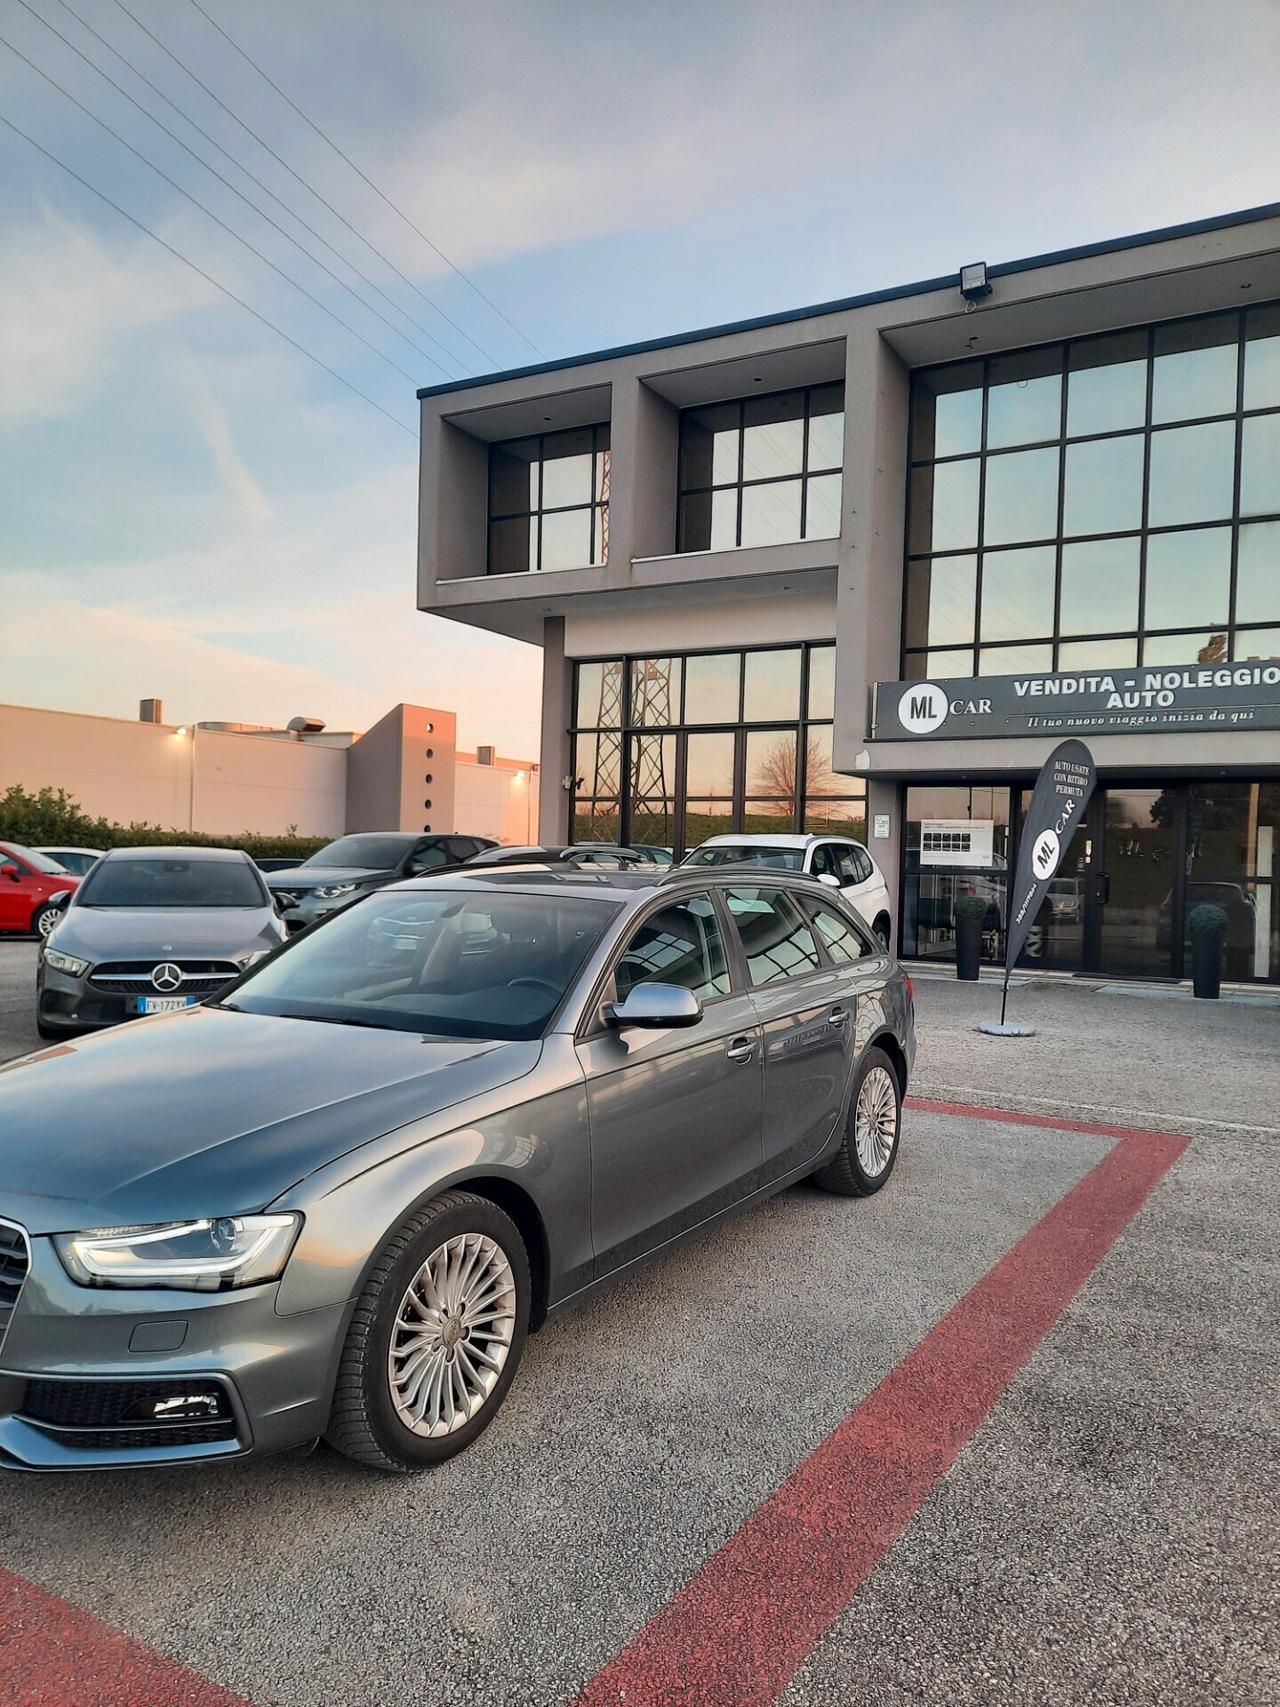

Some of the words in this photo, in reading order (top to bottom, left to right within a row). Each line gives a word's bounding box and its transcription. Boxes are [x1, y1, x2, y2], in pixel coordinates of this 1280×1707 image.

[1014, 676, 1116, 697] VENDITA
[1144, 666, 1280, 690] NOLEGGIO
[910, 696, 937, 719] ML
[949, 698, 993, 715] CAR
[1106, 690, 1175, 709] AUTO
[1027, 717, 1039, 727] Il
[1042, 717, 1062, 727] tuo
[1067, 717, 1105, 726] nuovo
[1109, 712, 1158, 726] viaggio
[1162, 711, 1203, 722] inizia
[1209, 710, 1226, 721] da
[1231, 709, 1255, 723] qui
[1054, 760, 1071, 771] AUTO
[1071, 763, 1090, 776] USATE
[1054, 772, 1067, 782] CON
[1067, 774, 1088, 786] RITIRO
[1055, 784, 1084, 797] PERMUTA
[1037, 842, 1056, 870] ML
[1055, 798, 1076, 834] CAR
